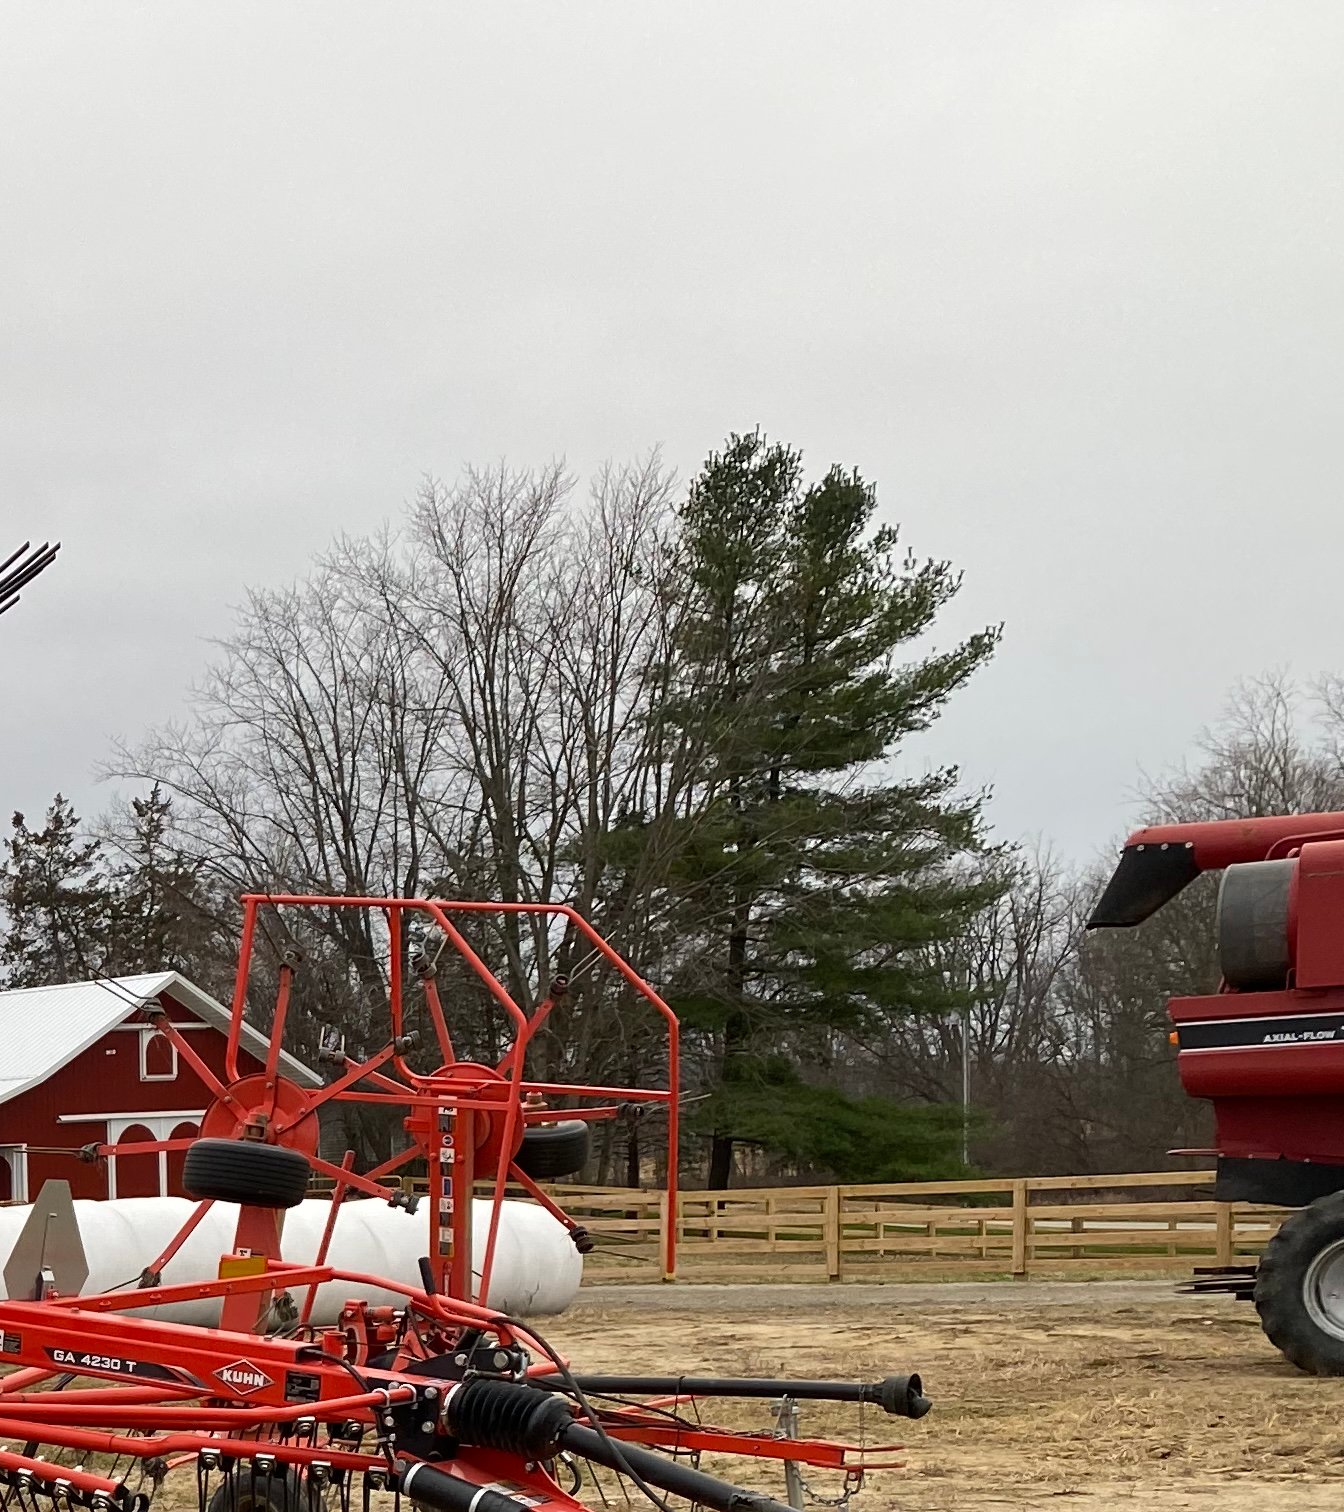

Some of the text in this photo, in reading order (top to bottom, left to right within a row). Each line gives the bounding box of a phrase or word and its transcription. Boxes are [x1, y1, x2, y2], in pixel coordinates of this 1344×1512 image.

[1263, 1030, 1336, 1043] AXIAL-FLOW
[53, 1349, 137, 1373] GA 4230 T
[222, 1369, 265, 1387] KUHN
